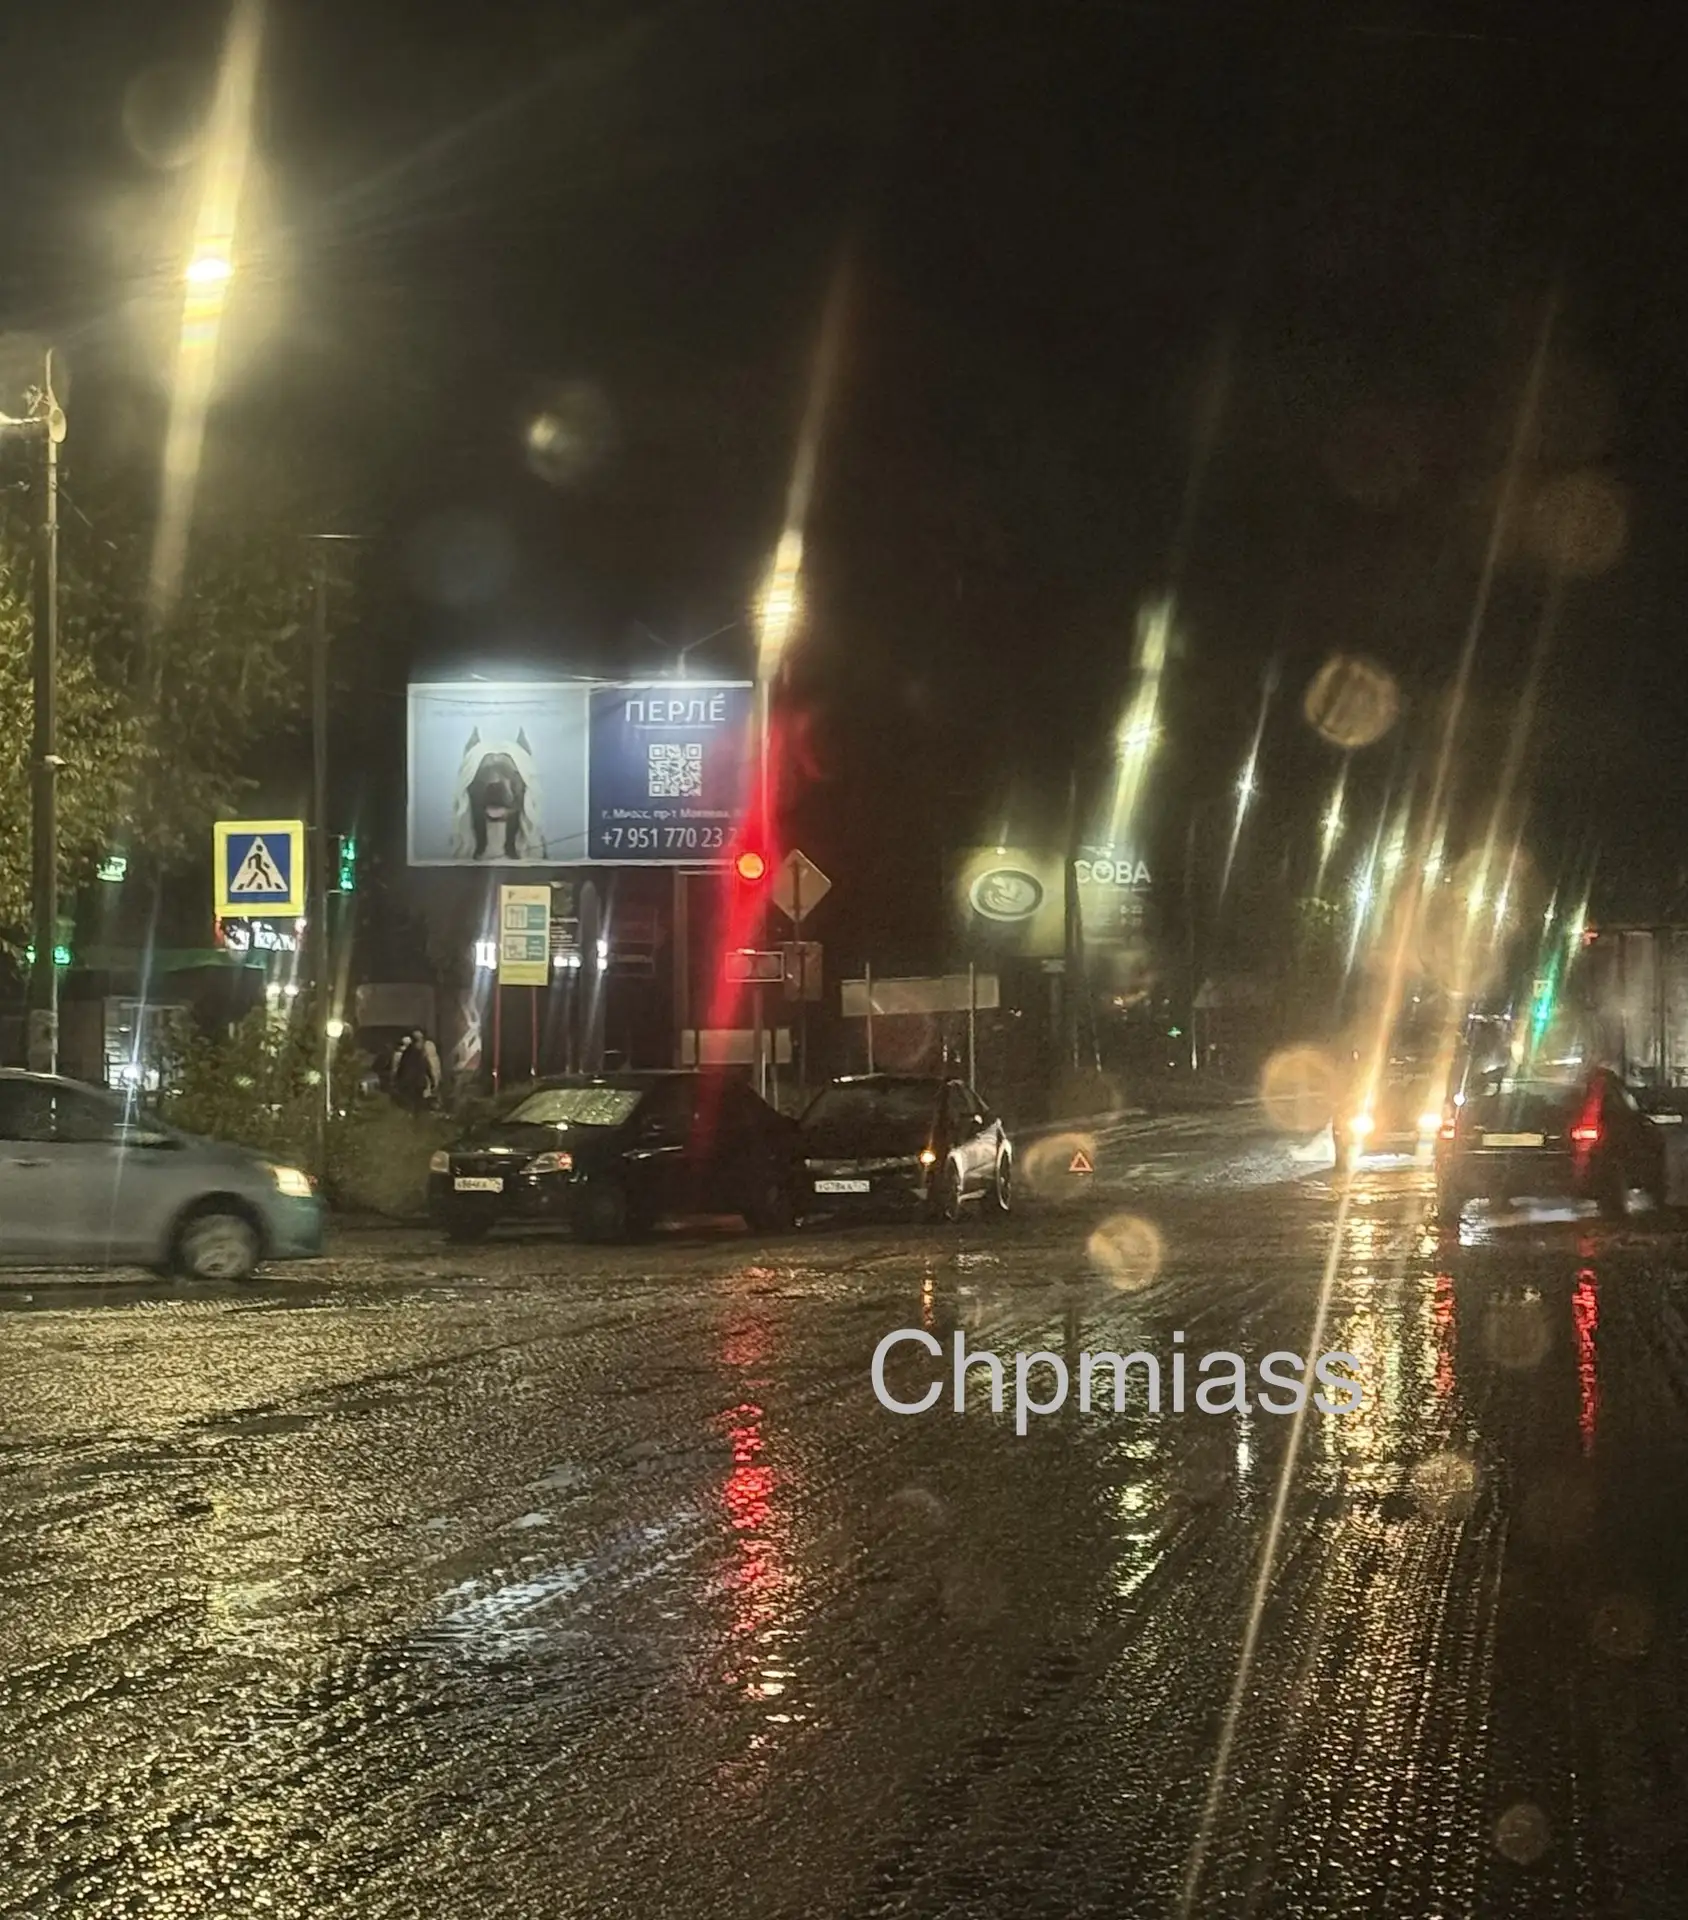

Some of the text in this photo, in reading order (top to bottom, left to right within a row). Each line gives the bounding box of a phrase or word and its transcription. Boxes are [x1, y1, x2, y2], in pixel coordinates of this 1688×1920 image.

[601, 827, 623, 849] +7
[627, 827, 659, 849] 951
[664, 827, 698, 849] 770
[700, 826, 723, 849] 23
[1074, 859, 1152, 884] СОВА
